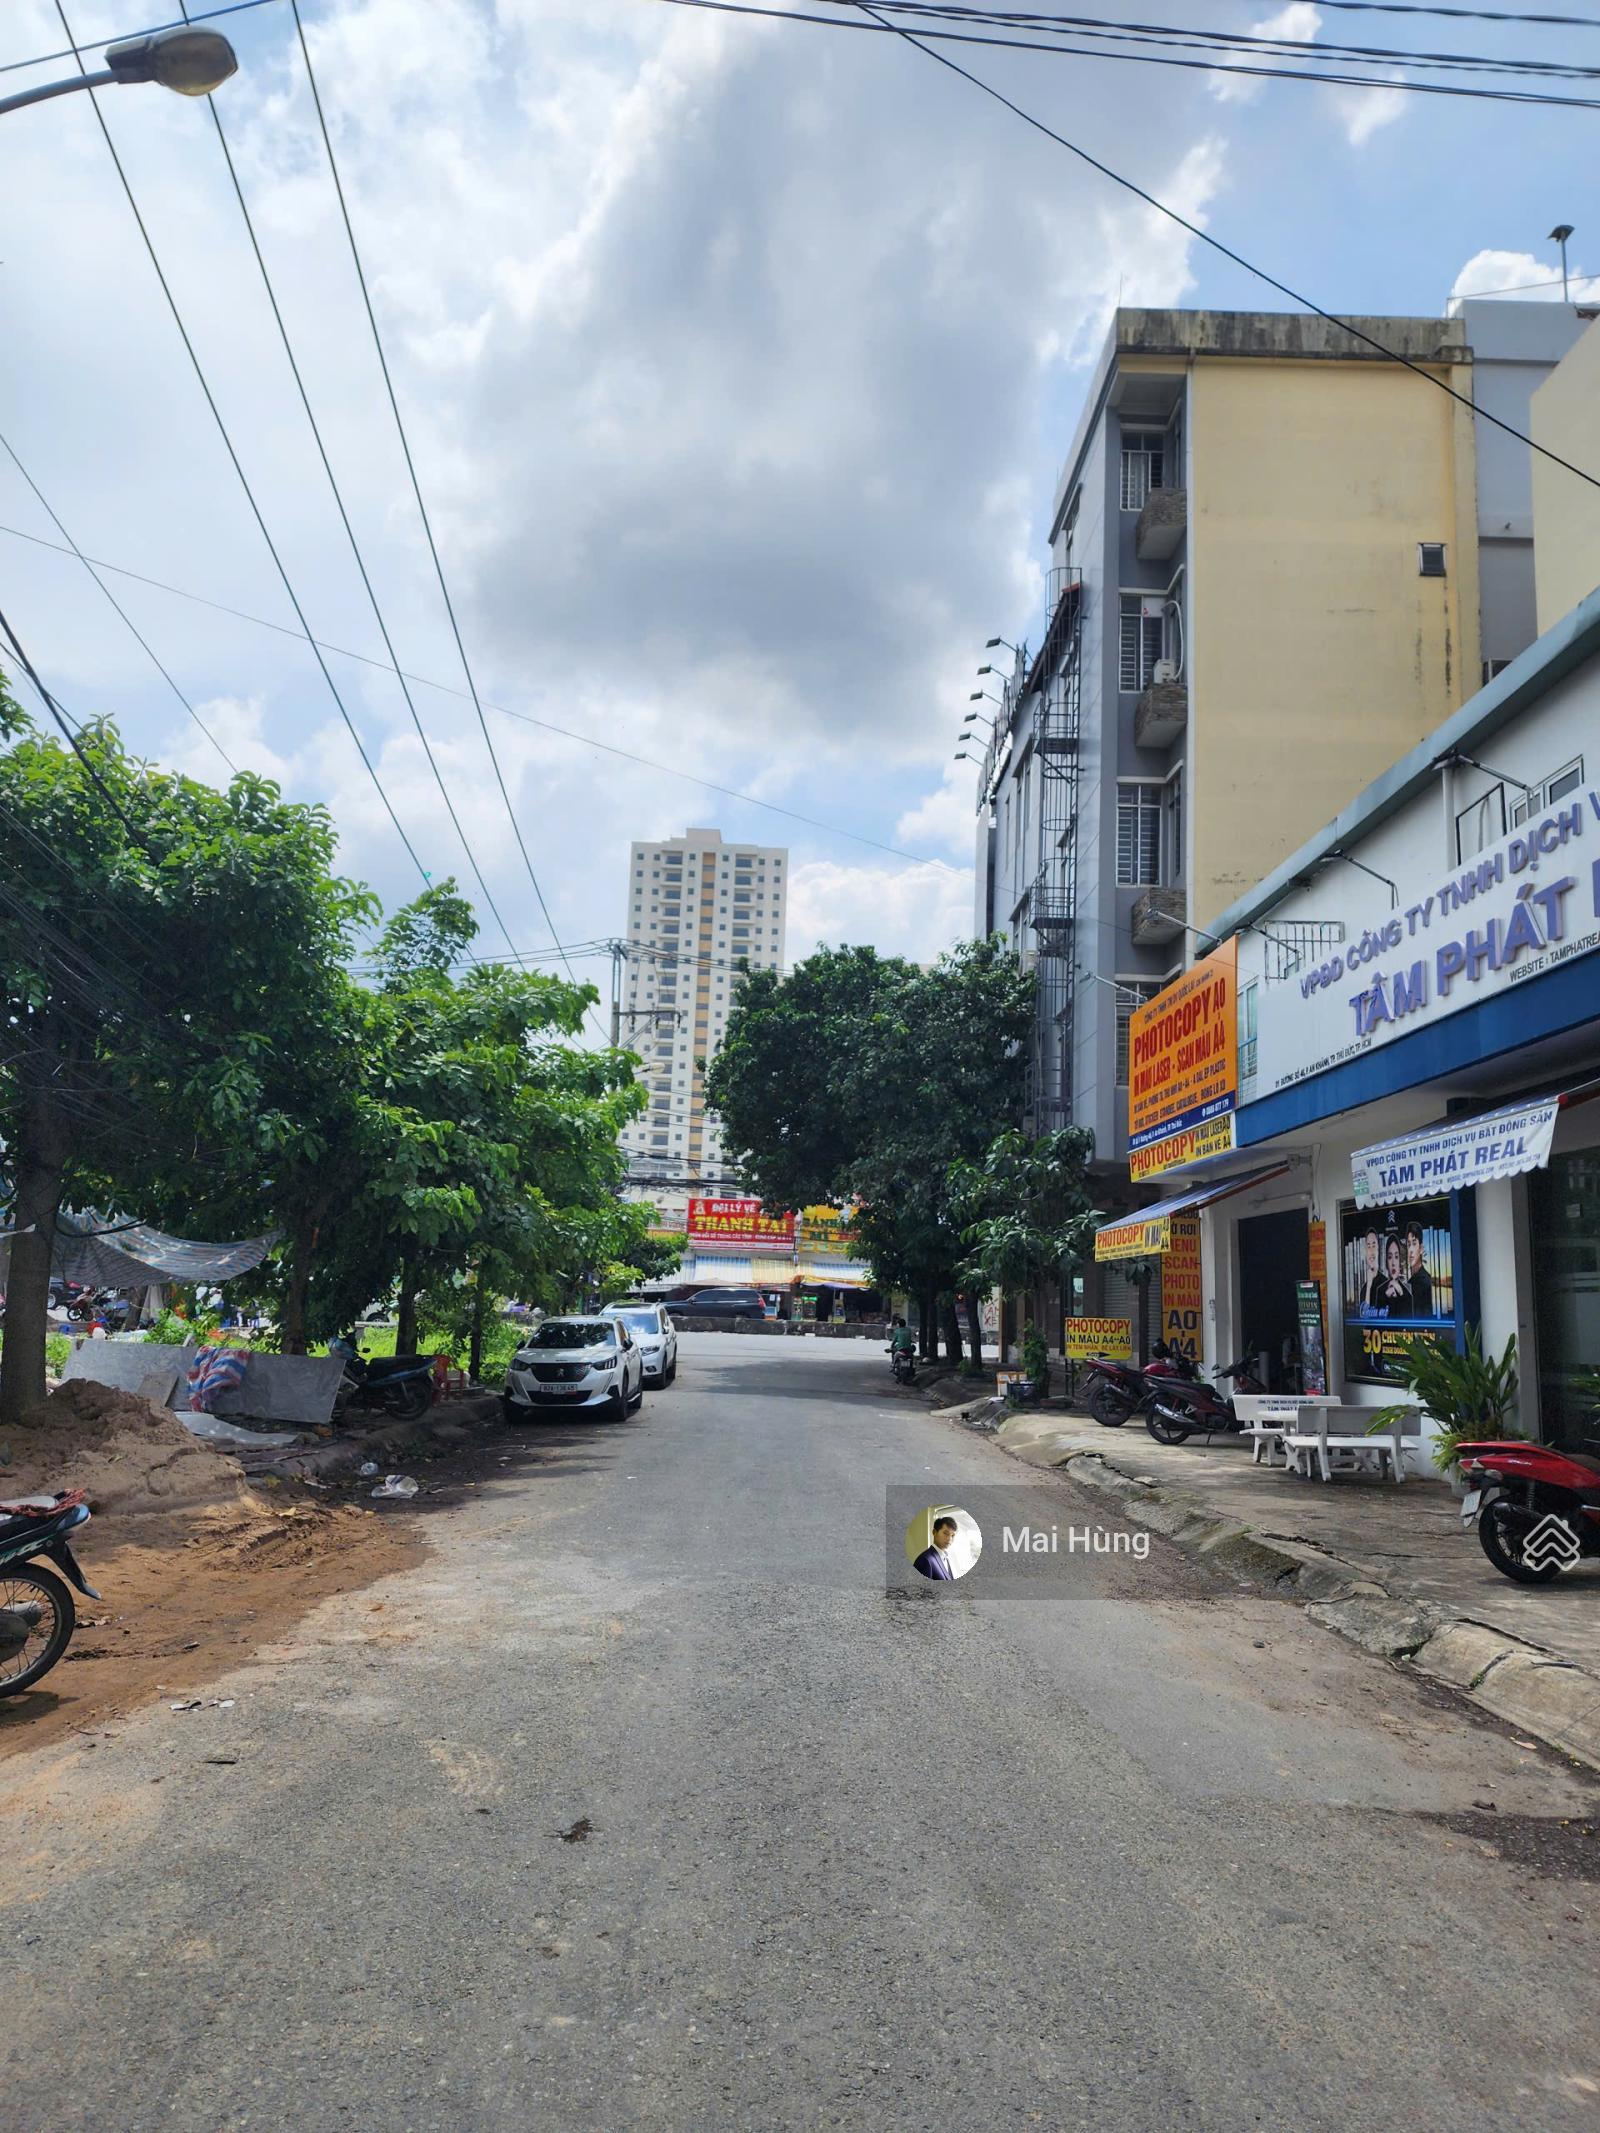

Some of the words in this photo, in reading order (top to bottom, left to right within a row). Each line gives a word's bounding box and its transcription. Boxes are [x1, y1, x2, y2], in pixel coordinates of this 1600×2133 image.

[1347, 920, 1401, 970] CÔNG
[1405, 897, 1434, 936] TY
[1437, 853, 1503, 915] TNHH
[1509, 803, 1581, 872] DỊCH
[1349, 960, 1427, 1037] TÂM
[1437, 876, 1578, 997] PHÁT
[1510, 959, 1544, 983] WEBSITE
[1134, 987, 1211, 1068] PHOTOCOPY
[1213, 977, 1226, 1012] A0
[1153, 1056, 1171, 1088] LASER
[1177, 1042, 1194, 1073] SCAN
[1195, 1030, 1210, 1064] MÀU
[1213, 1020, 1226, 1055] A4
[1210, 1058, 1225, 1077] PLASTIC
[1223, 1135, 1231, 1149] A4
[1386, 1149, 1406, 1163] CÔNG
[1407, 1148, 1417, 1158] TY
[1419, 1143, 1440, 1156] TNHH
[1443, 1137, 1463, 1150] DỊCH
[1465, 1133, 1477, 1144] VỤ
[1499, 1117, 1526, 1134] ĐỘNG
[1131, 1131, 1195, 1174] PHOTOCOPY
[1379, 1164, 1414, 1188] TÂM
[1420, 1150, 1469, 1178] PHÁT
[1475, 1136, 1528, 1166] REAL
[730, 1201, 741, 1213] LÝ
[695, 1216, 754, 1231] THANH
[1098, 1224, 1145, 1249] PHOTOCOPY
[1165, 1274, 1199, 1289] PHOTO
[1165, 1296, 1173, 1307] IN
[1067, 1319, 1130, 1335] PHOTOCOPY
[1168, 1310, 1197, 1330] A0
[1067, 1334, 1075, 1343] IN
[1079, 1333, 1099, 1344] MÀU
[1169, 1337, 1197, 1359] A4
[1363, 1329, 1381, 1353] 30
